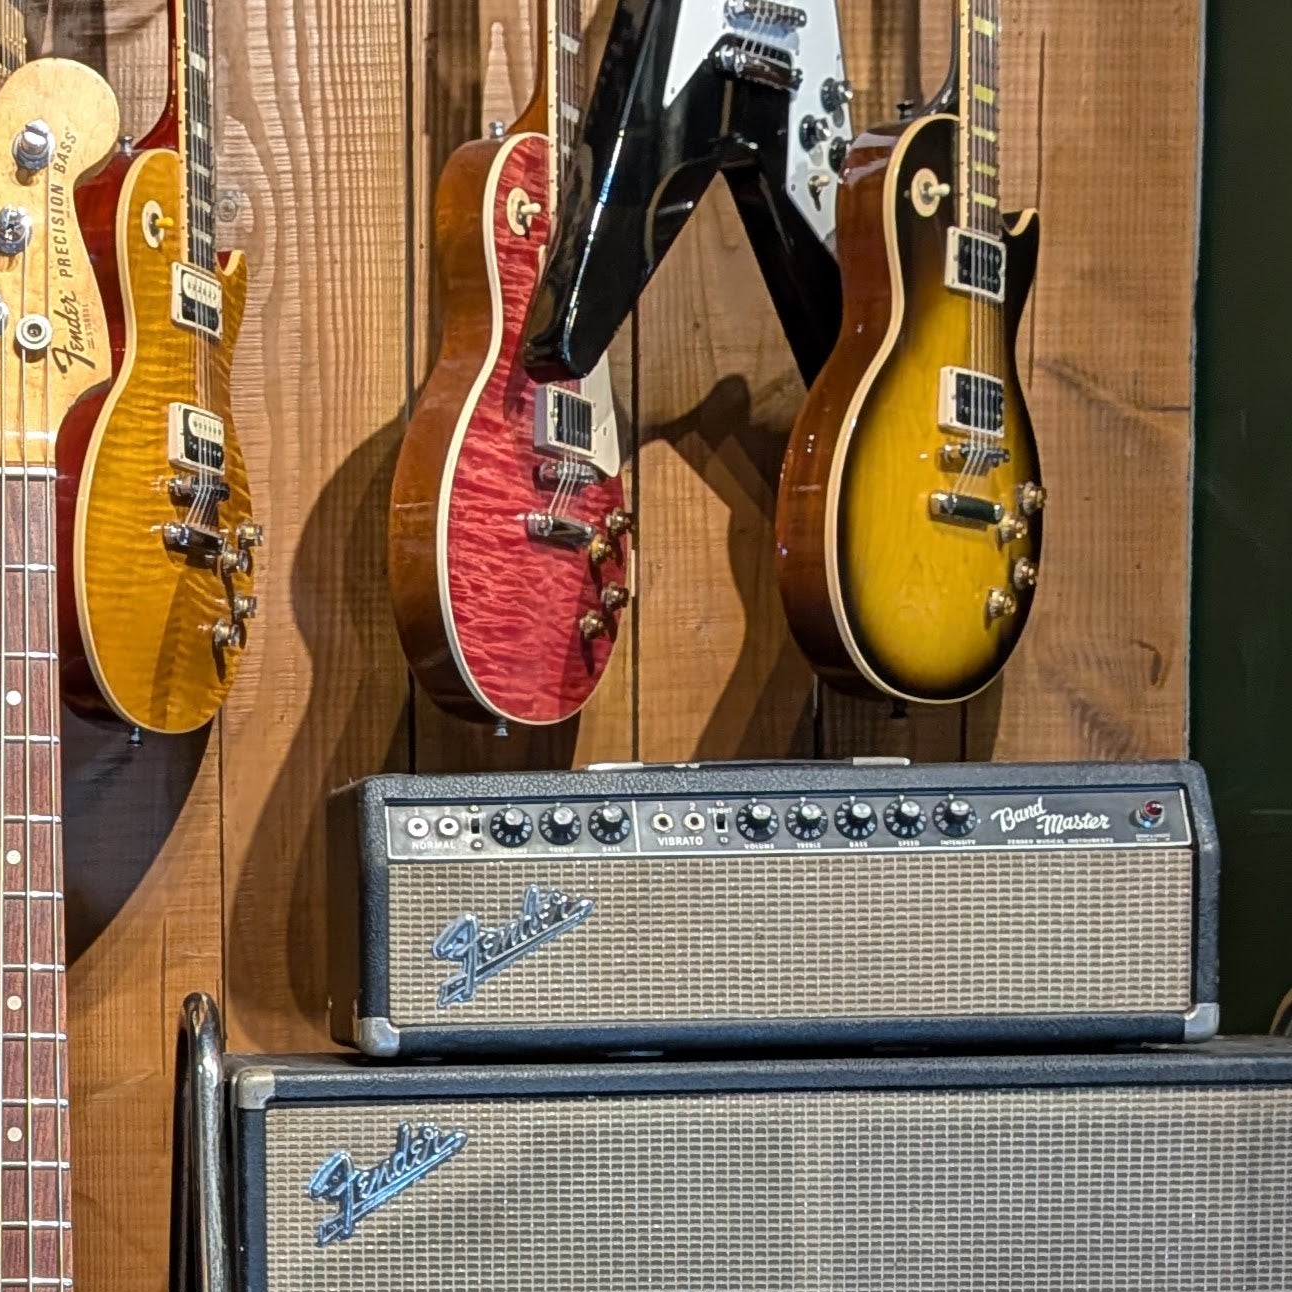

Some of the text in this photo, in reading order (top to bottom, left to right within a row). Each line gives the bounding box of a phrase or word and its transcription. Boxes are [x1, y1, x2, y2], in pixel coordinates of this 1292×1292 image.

[53, 129, 77, 175] BASS
[49, 184, 73, 279] PRECISION
[51, 290, 96, 375] Fender
[689, 802, 697, 812] 2
[990, 796, 1048, 833] Band
[411, 840, 456, 850] NORMAL
[657, 836, 704, 846] VIBRATO
[431, 883, 597, 1008] Fender
[308, 1121, 469, 1247] Fender
